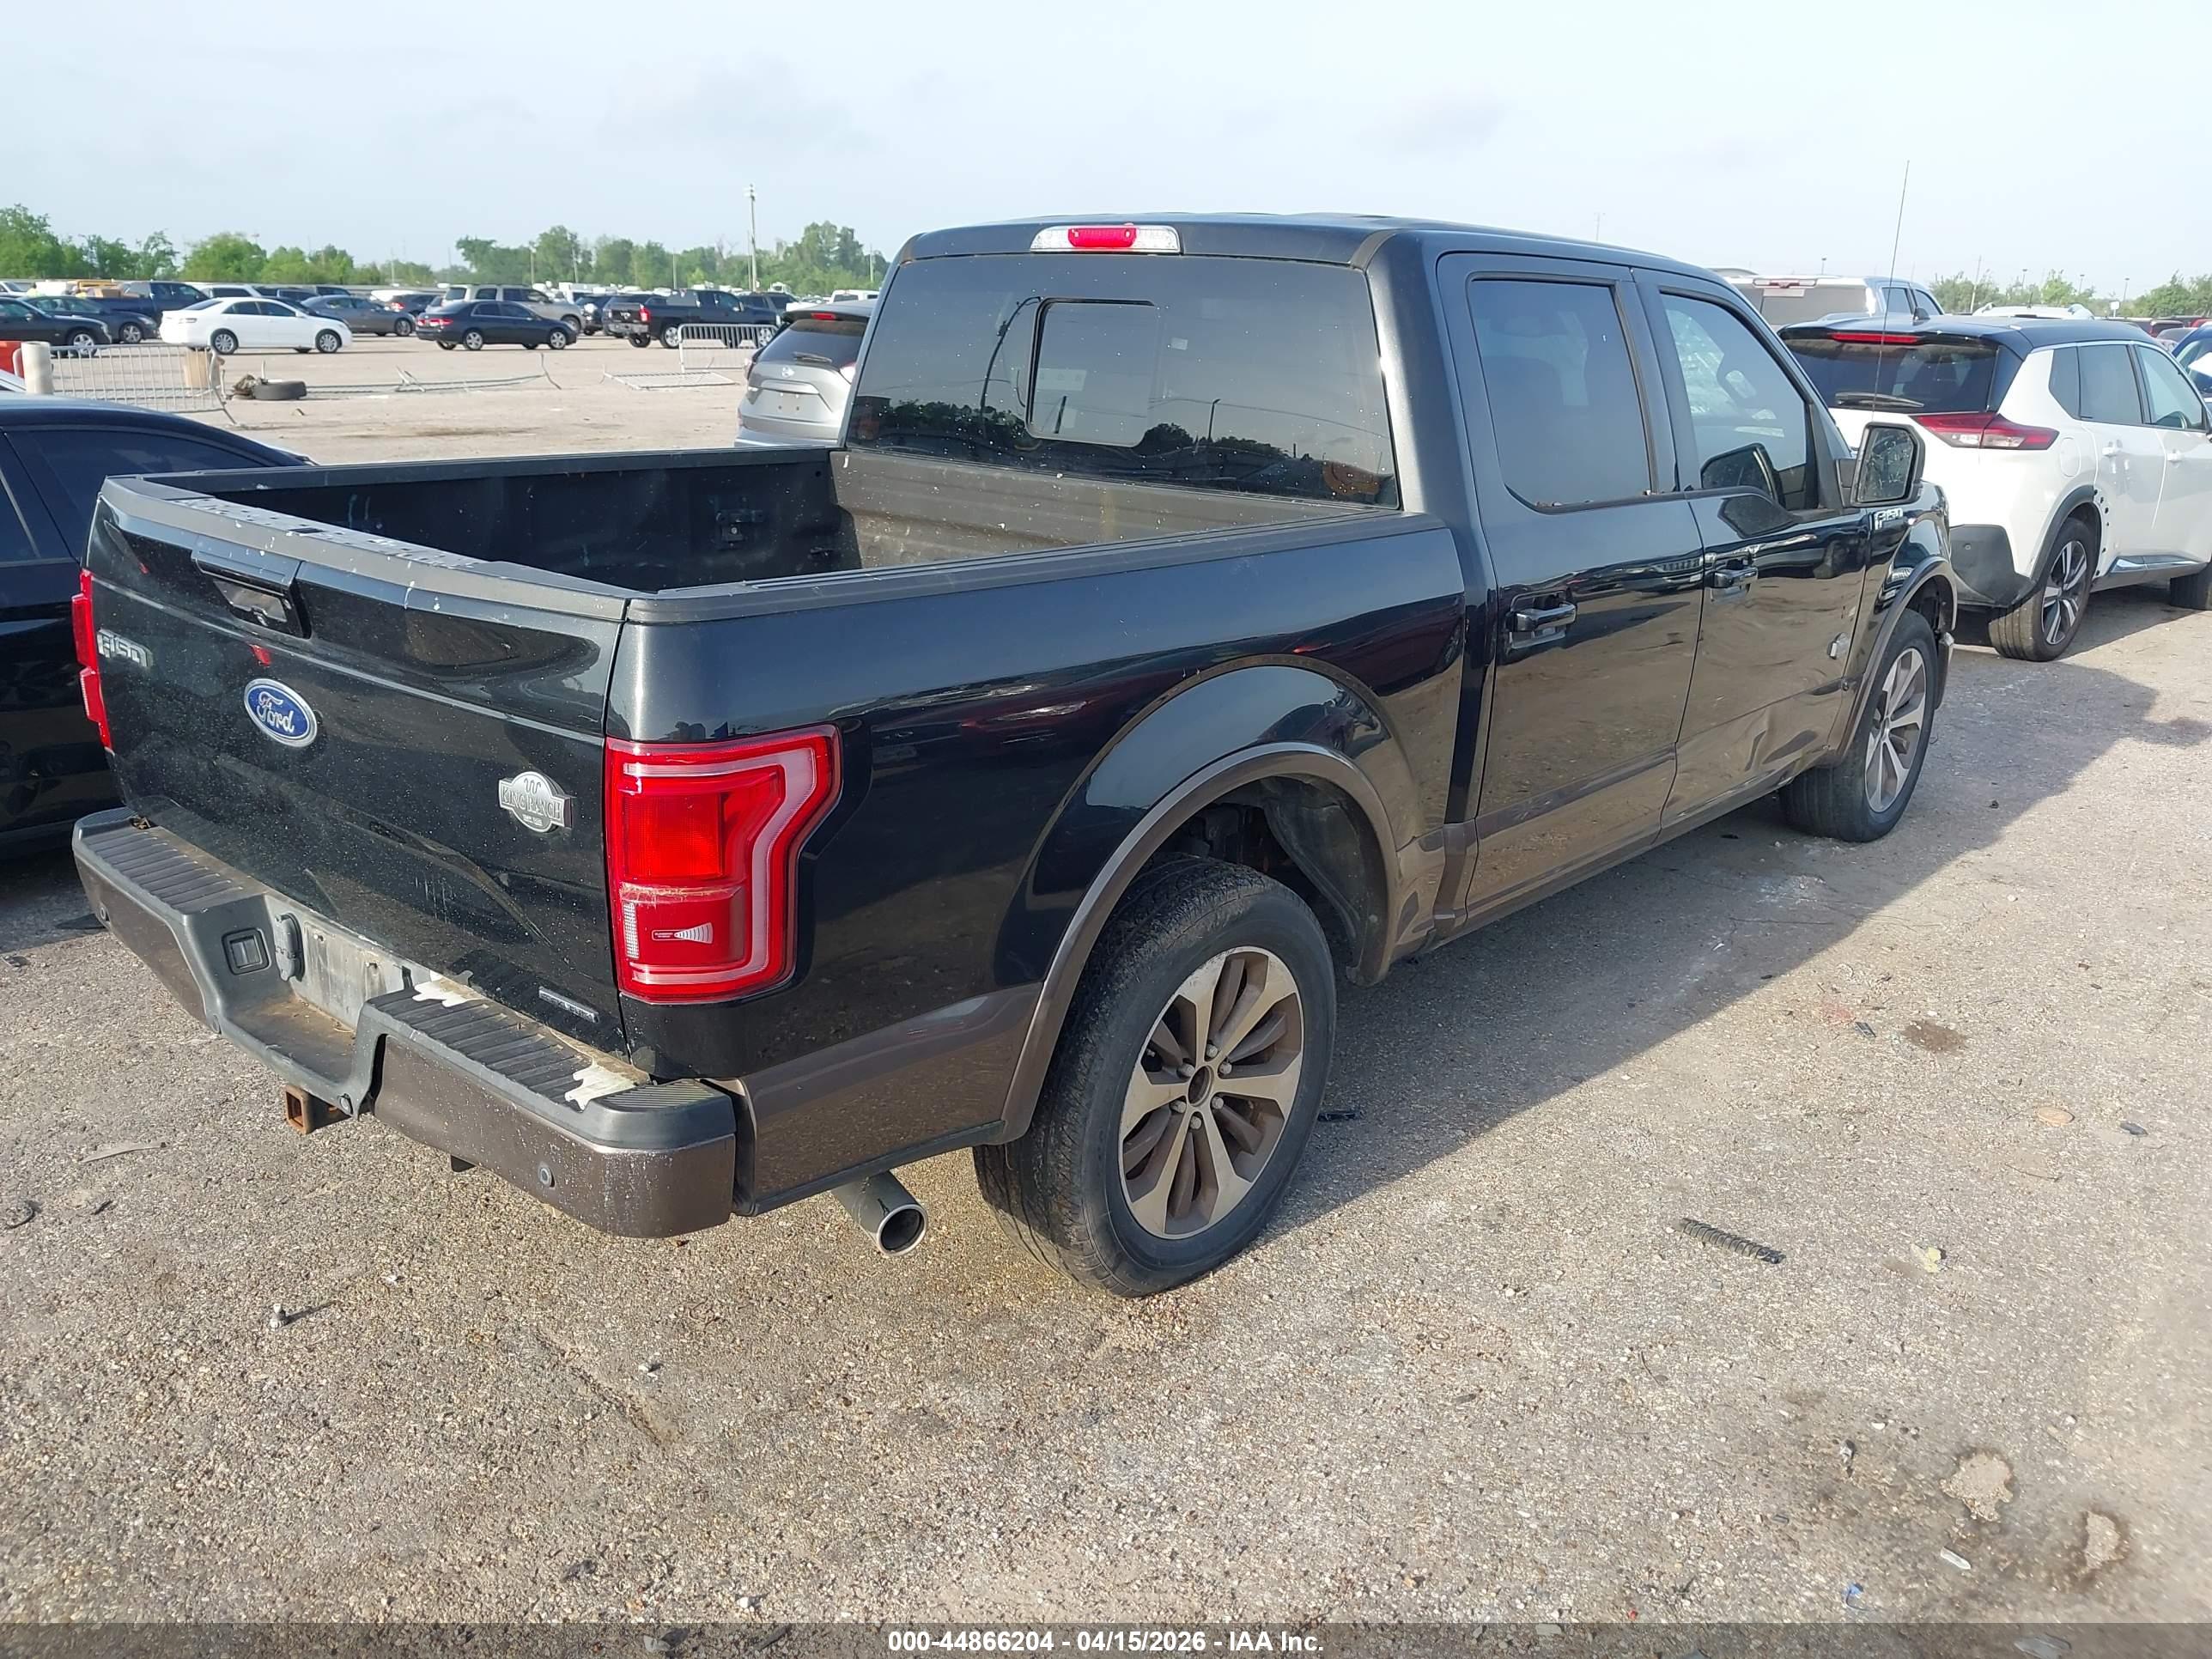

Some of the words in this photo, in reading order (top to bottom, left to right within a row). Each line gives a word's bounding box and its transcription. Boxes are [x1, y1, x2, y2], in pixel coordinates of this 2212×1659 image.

[257, 690, 295, 733] Ford
[501, 786, 526, 810] KING
[527, 795, 562, 819] RANCH
